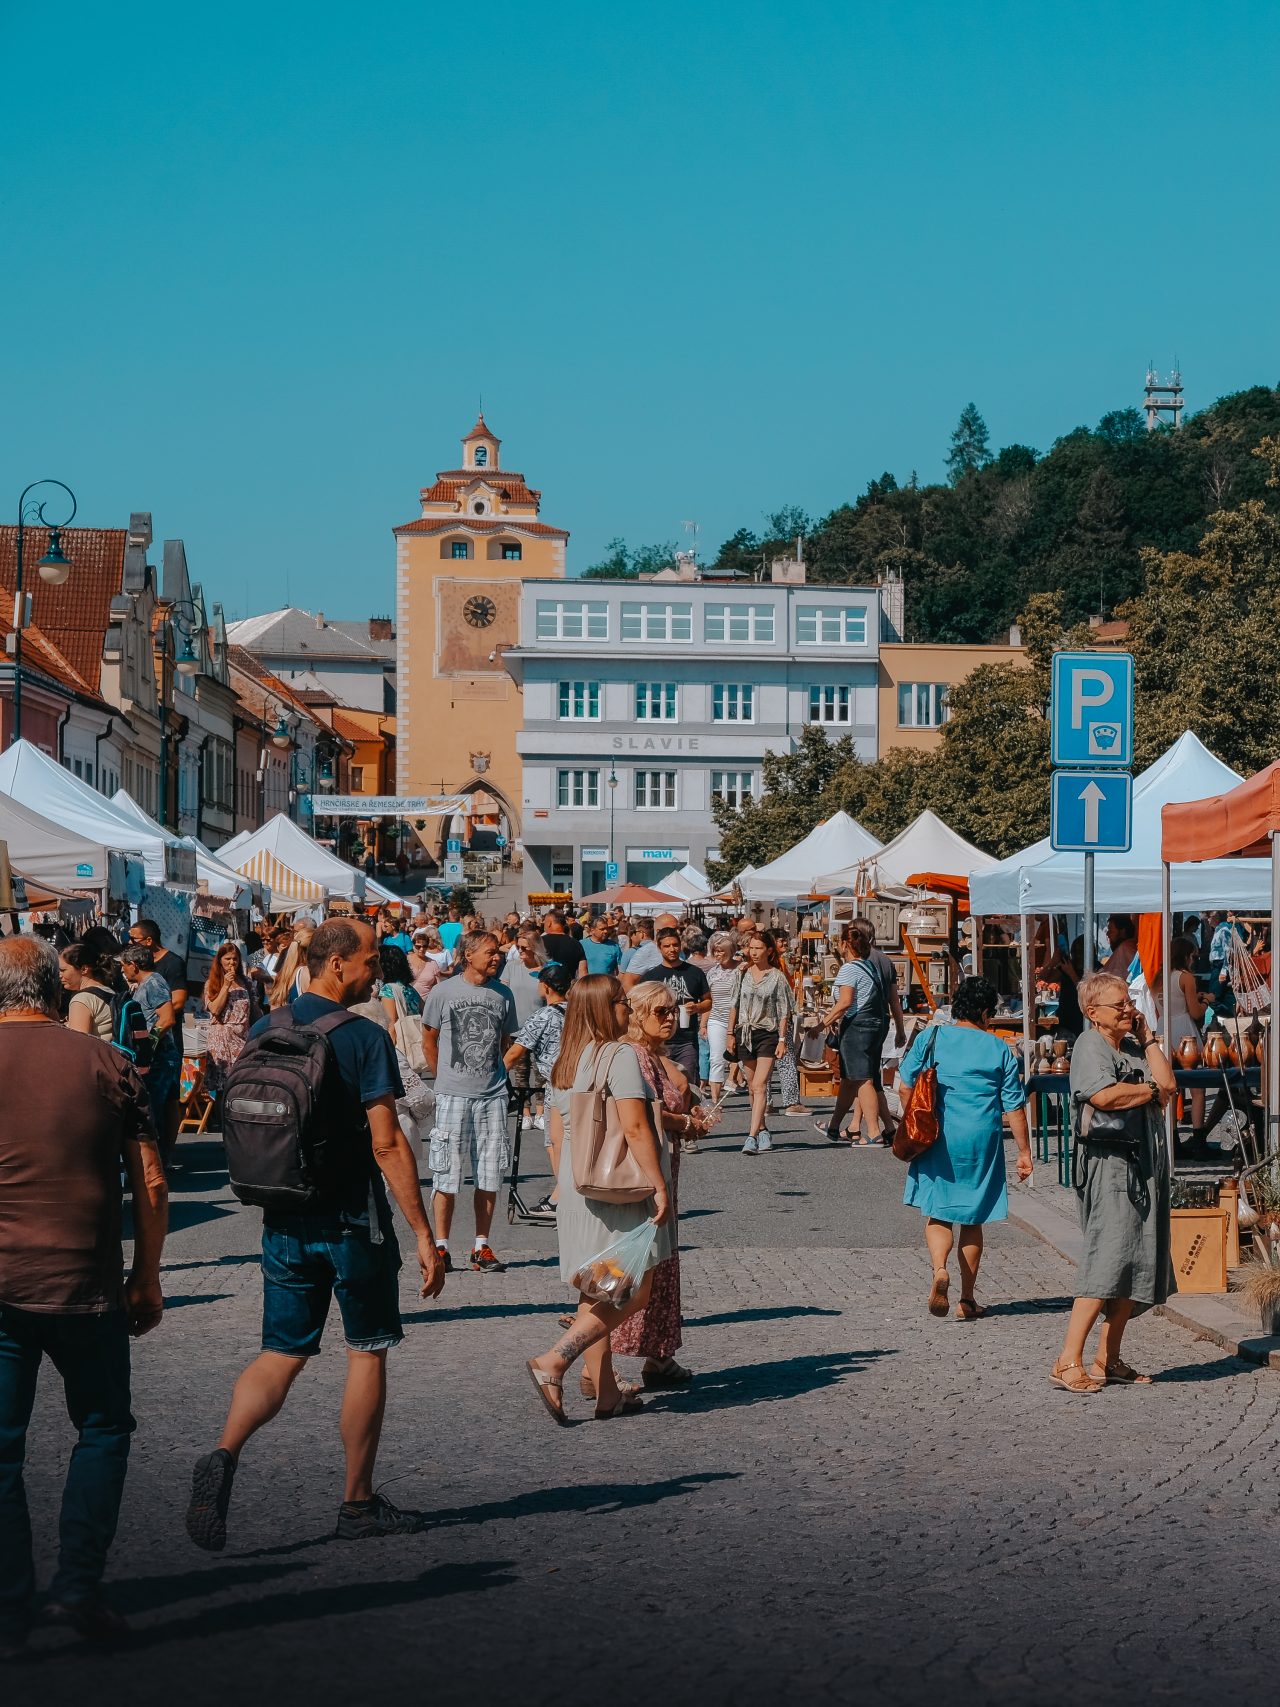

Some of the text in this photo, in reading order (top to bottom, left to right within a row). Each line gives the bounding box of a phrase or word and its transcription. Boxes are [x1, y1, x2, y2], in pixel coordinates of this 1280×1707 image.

[1071, 668, 1115, 730] P
[612, 736, 699, 750] SLAVIE
[642, 848, 673, 859] mavi
[608, 864, 616, 875] P
